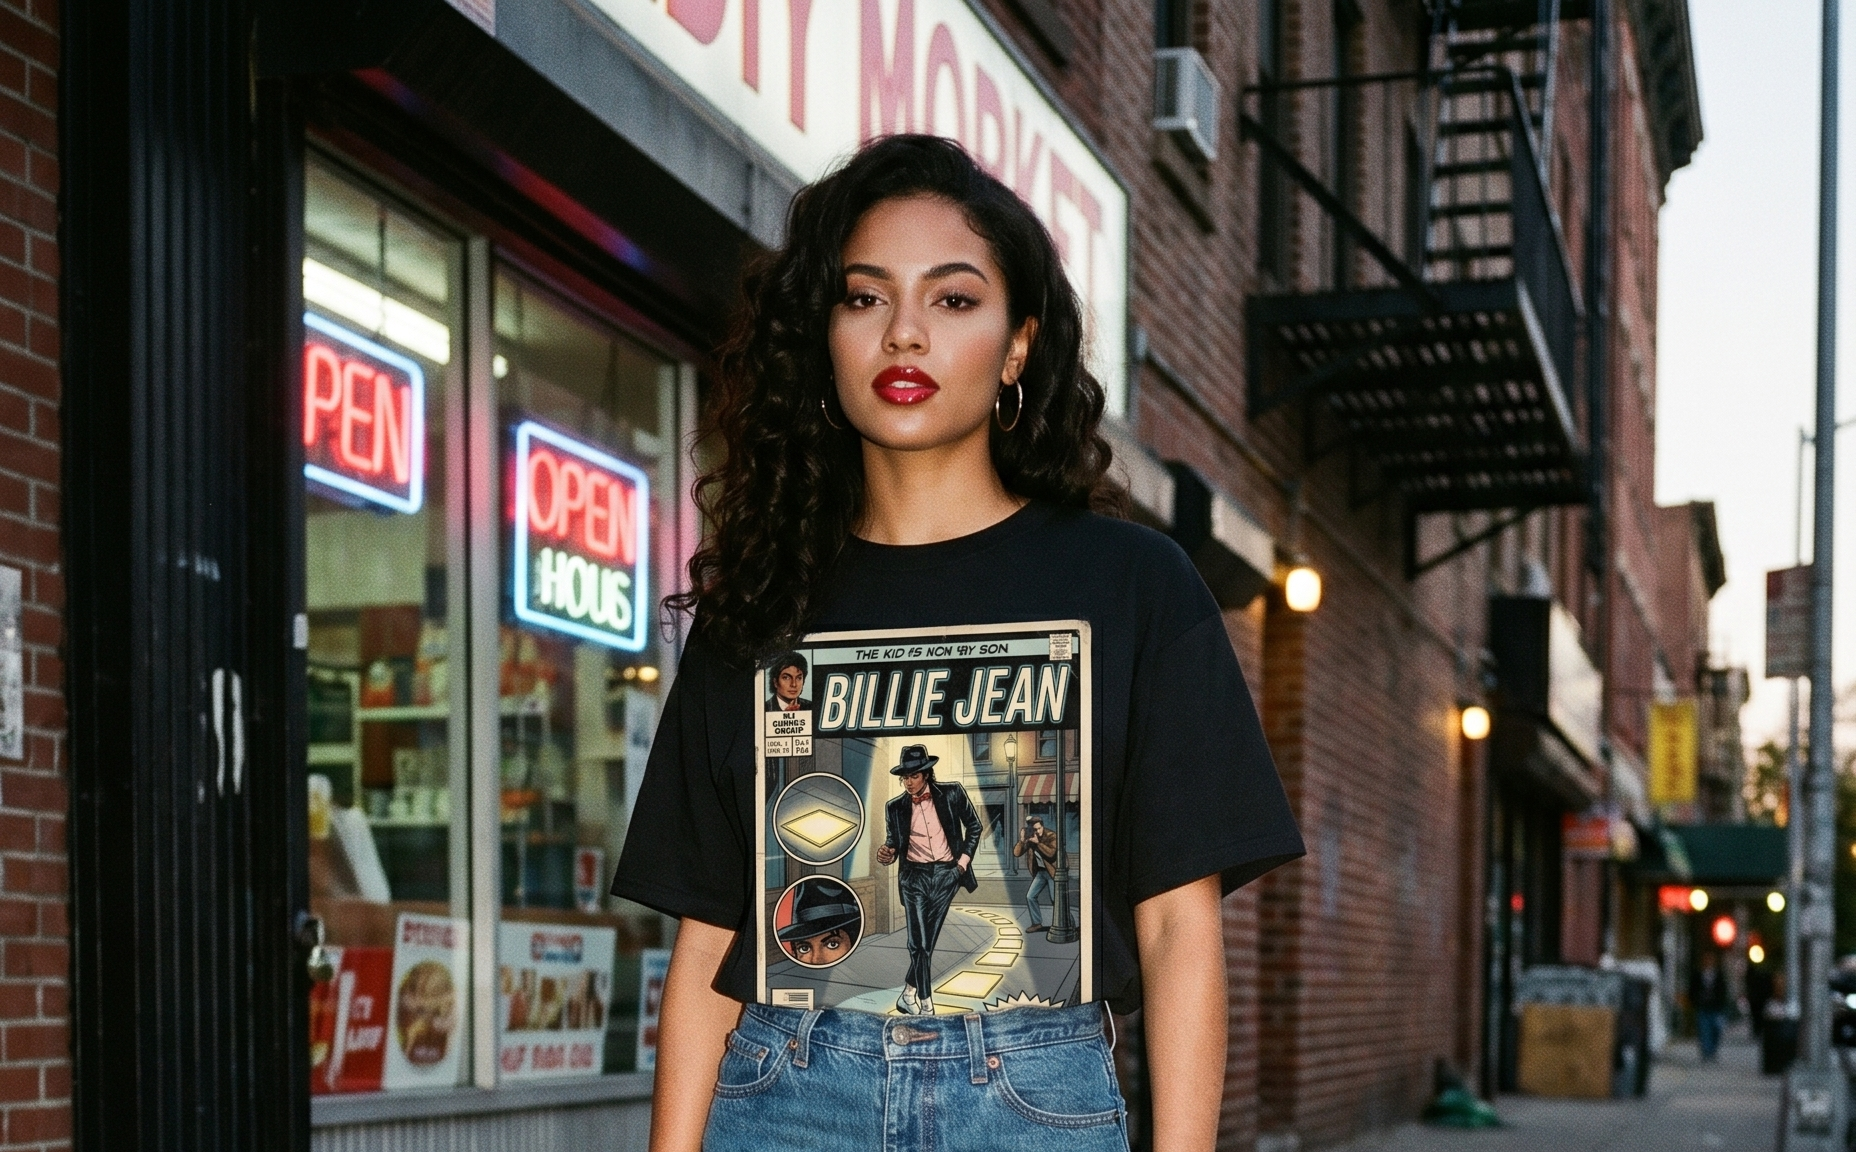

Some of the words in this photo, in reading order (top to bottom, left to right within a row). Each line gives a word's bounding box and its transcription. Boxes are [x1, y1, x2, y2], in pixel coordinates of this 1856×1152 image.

[305, 344, 411, 484] PEN
[528, 450, 637, 565] OPEN
[819, 669, 949, 731] BILLIE
[954, 663, 1071, 727] JEAN
[856, 650, 879, 660] THE
[883, 648, 905, 659] KID
[979, 643, 1009, 655] SON
